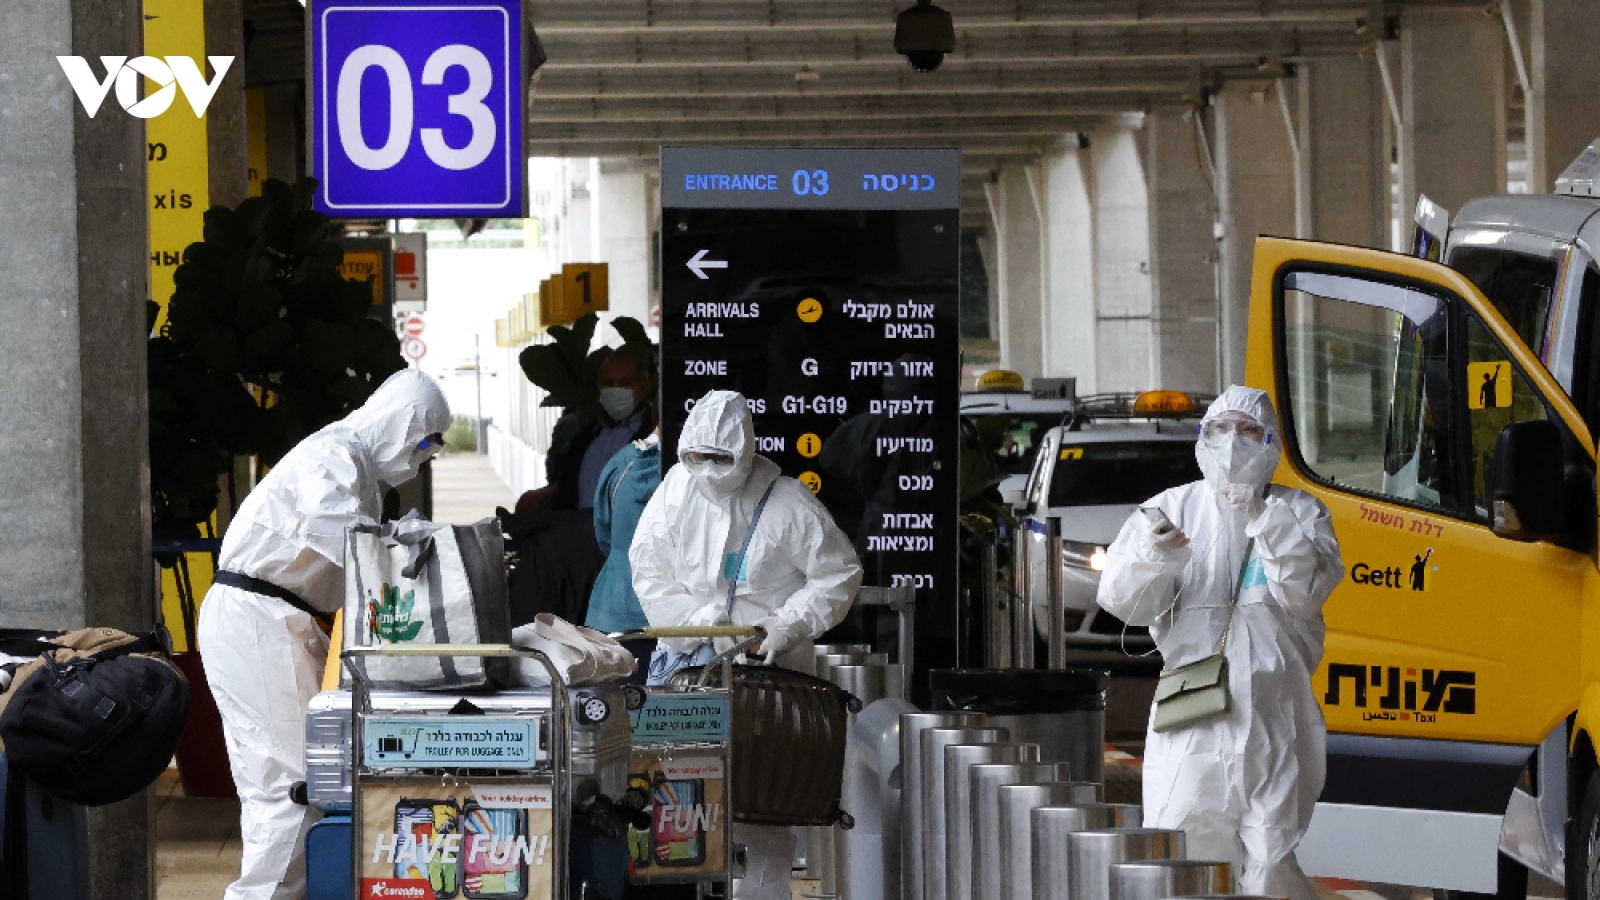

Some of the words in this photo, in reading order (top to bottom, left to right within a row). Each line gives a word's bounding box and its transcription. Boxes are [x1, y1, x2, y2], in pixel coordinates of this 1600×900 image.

[336, 44, 497, 170] 03
[685, 174, 778, 191] ENTRANCE
[791, 169, 830, 196] 03
[862, 174, 936, 192] כניסה
[154, 189, 193, 209] xis
[575, 271, 591, 304] 1
[685, 302, 760, 318] ARRIVALS
[842, 299, 892, 322] מקבלי
[897, 300, 935, 318] אולם
[684, 323, 724, 338] HALL
[884, 323, 935, 339] הבאים
[684, 360, 727, 376] ZONE
[801, 358, 819, 376] G
[850, 361, 894, 380] בידוק
[900, 361, 934, 377] אזור
[782, 395, 848, 414] G1-G19
[869, 397, 934, 419] דלפקים
[876, 437, 934, 457] מודיעין
[898, 475, 934, 491] מכס
[882, 513, 934, 530] אבדות
[1359, 503, 1404, 529] חשמל
[1409, 519, 1444, 538] דלת
[866, 535, 934, 552] ומציאות
[1351, 562, 1402, 589] Gett
[1324, 662, 1476, 714] מונית
[1412, 711, 1437, 723] Taxi
[455, 747, 470, 756] FOR
[471, 747, 504, 756] LUGGAGE
[658, 803, 720, 832] FUN!
[372, 834, 460, 864] HAVE
[468, 835, 549, 866] FUN!
